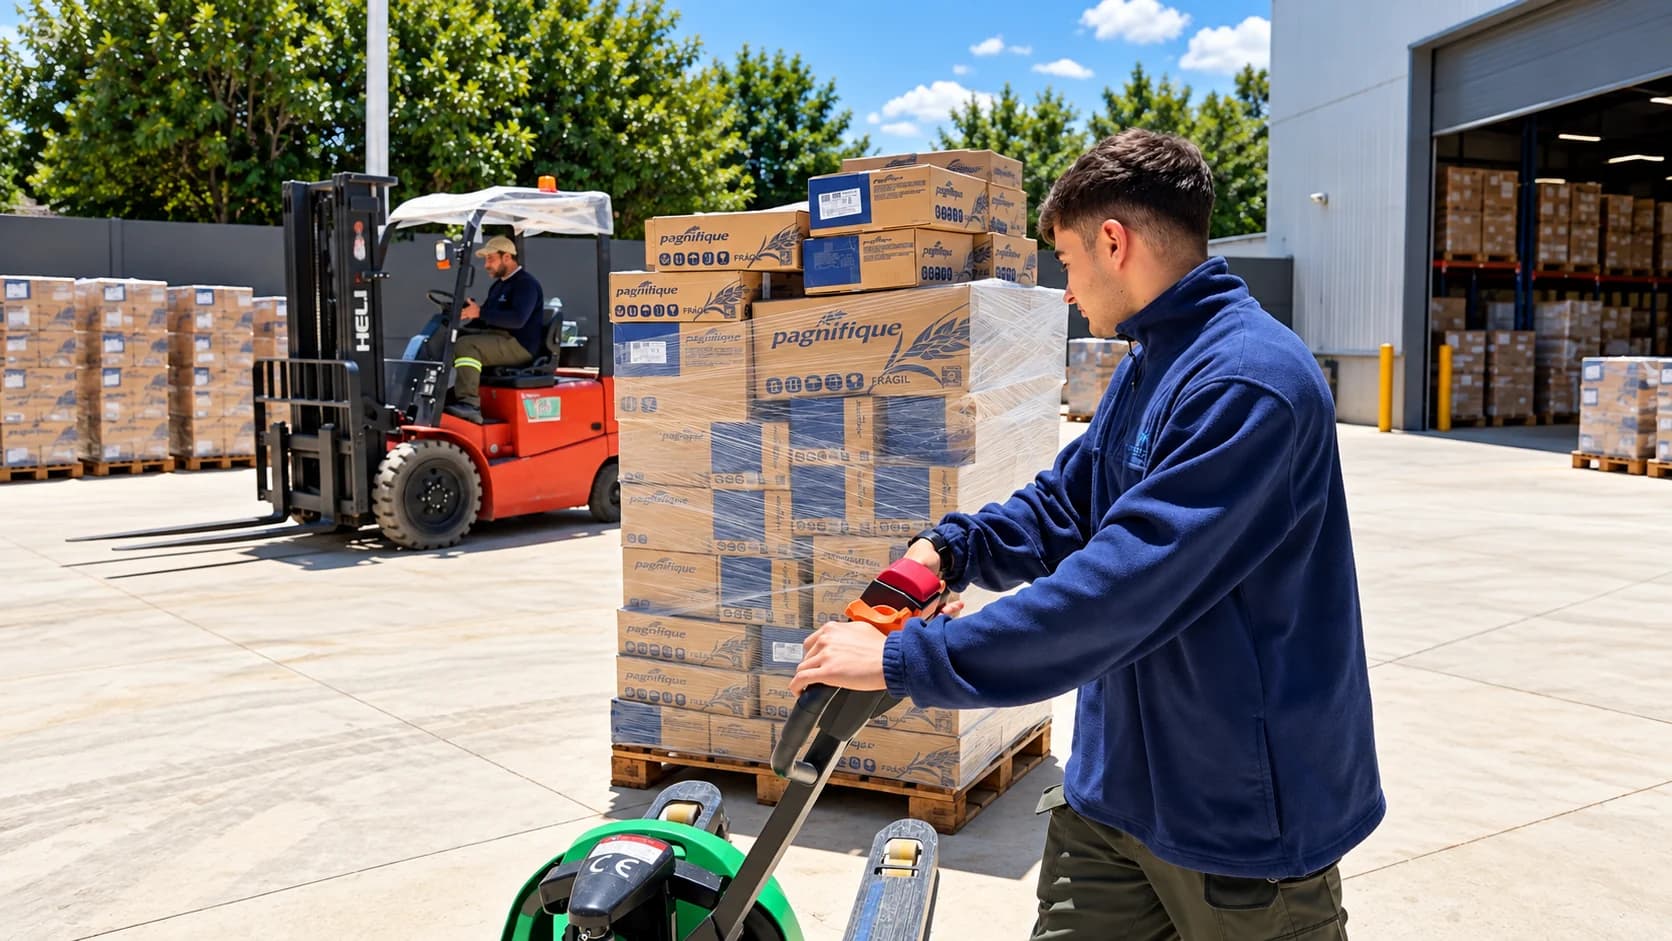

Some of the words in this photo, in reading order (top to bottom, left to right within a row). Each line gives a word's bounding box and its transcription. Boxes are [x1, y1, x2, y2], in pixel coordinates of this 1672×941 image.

[660, 230, 729, 246] pagnifique
[616, 284, 678, 298] pagnifique
[354, 290, 370, 352] HELI
[771, 320, 902, 350] pagnifique
[634, 559, 697, 574] pagnifique
[589, 854, 640, 879] CE
